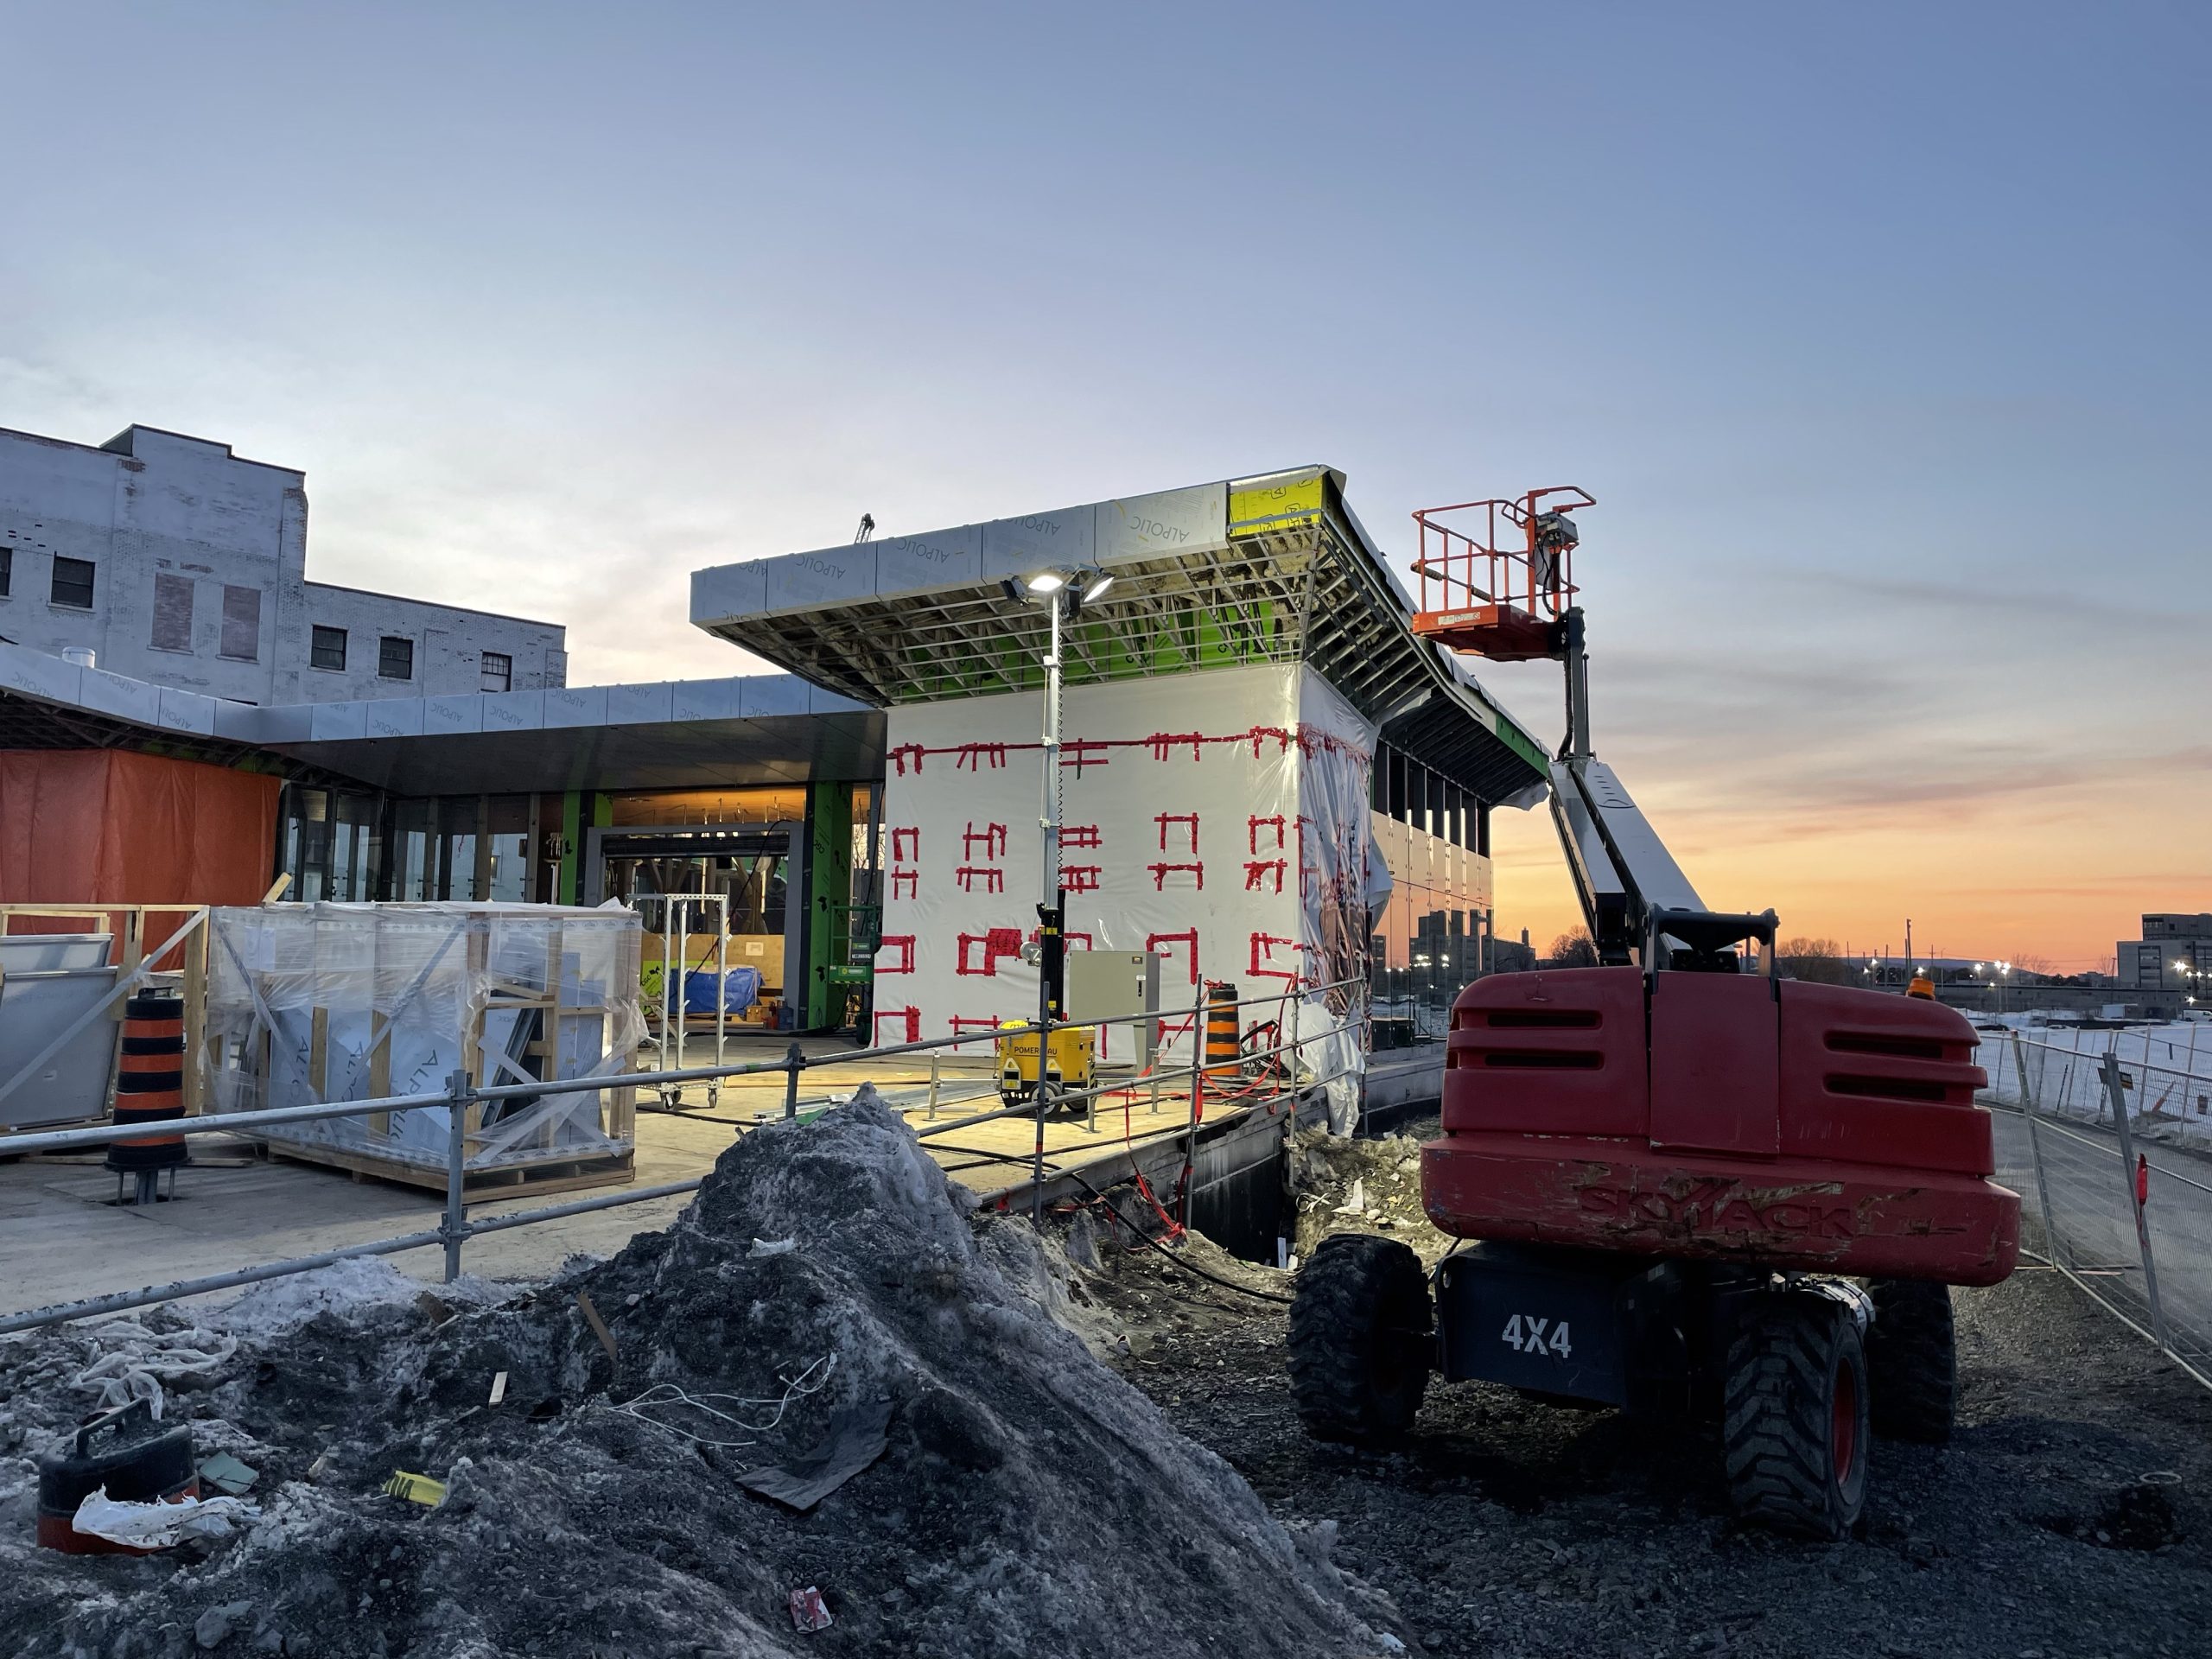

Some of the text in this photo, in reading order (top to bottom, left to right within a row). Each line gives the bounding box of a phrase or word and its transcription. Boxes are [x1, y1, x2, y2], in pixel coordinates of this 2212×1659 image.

[1128, 516, 1190, 543] ALPOLIC
[896, 537, 950, 563] ALPOLIC
[796, 555, 846, 579] ALPOLIC
[551, 689, 586, 708] ALPOLIC
[432, 702, 463, 722] ALPOLIC
[490, 705, 524, 726] ALPOLIC
[1014, 1046, 1058, 1055] POMERAU
[1581, 1177, 1855, 1239] SKYJACK
[1502, 1314, 1572, 1359] 4X4
